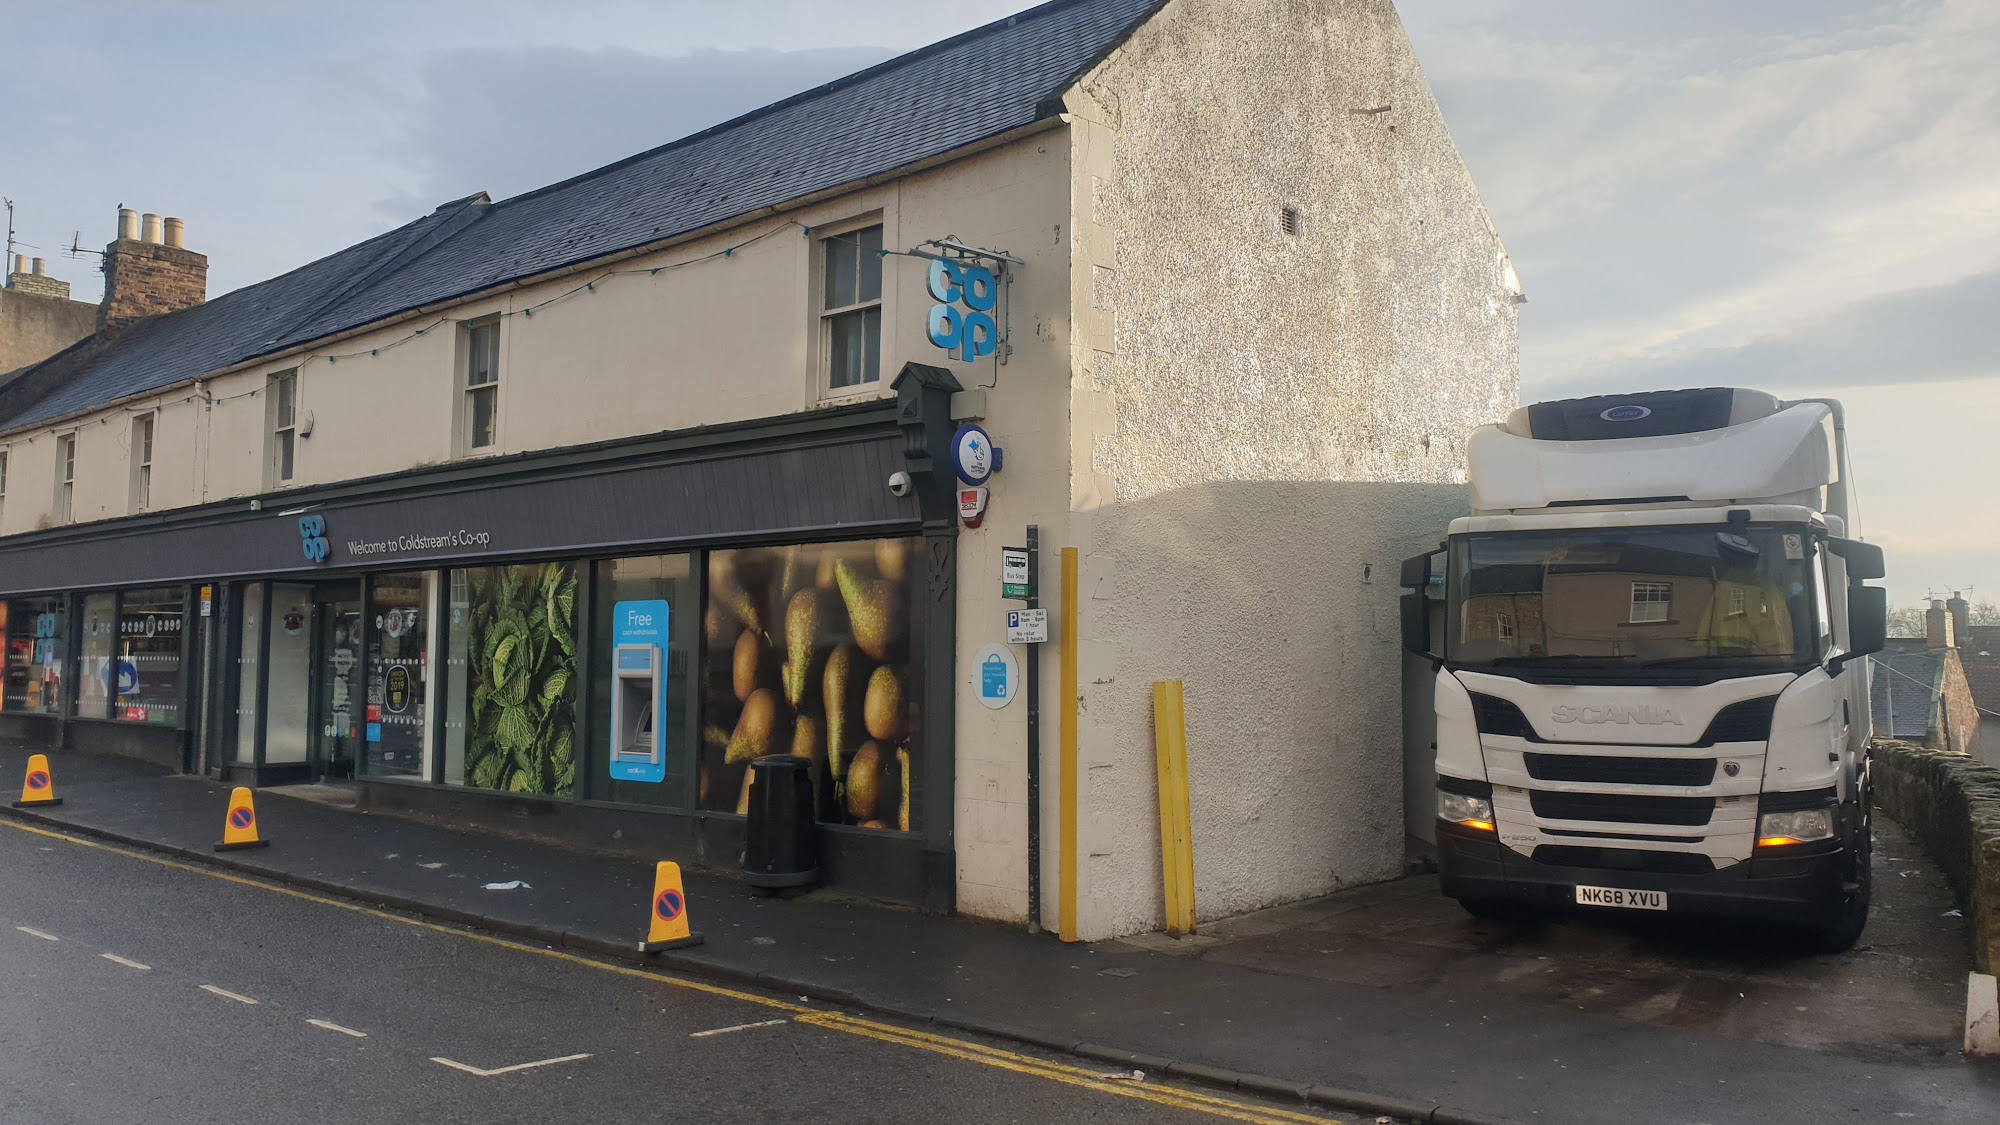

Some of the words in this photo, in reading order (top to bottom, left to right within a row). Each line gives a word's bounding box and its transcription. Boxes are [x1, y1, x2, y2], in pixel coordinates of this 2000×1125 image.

[348, 540, 387, 555] Welcome
[388, 540, 398, 552] to
[399, 532, 458, 551] Coldstream's
[459, 530, 490, 549] Co-op
[628, 610, 652, 626] Free
[1010, 613, 1018, 627] P
[390, 681, 405, 691] 2019
[1551, 704, 1684, 726] SCANIA
[1582, 888, 1623, 904] NK68
[1628, 891, 1660, 907] XVU
